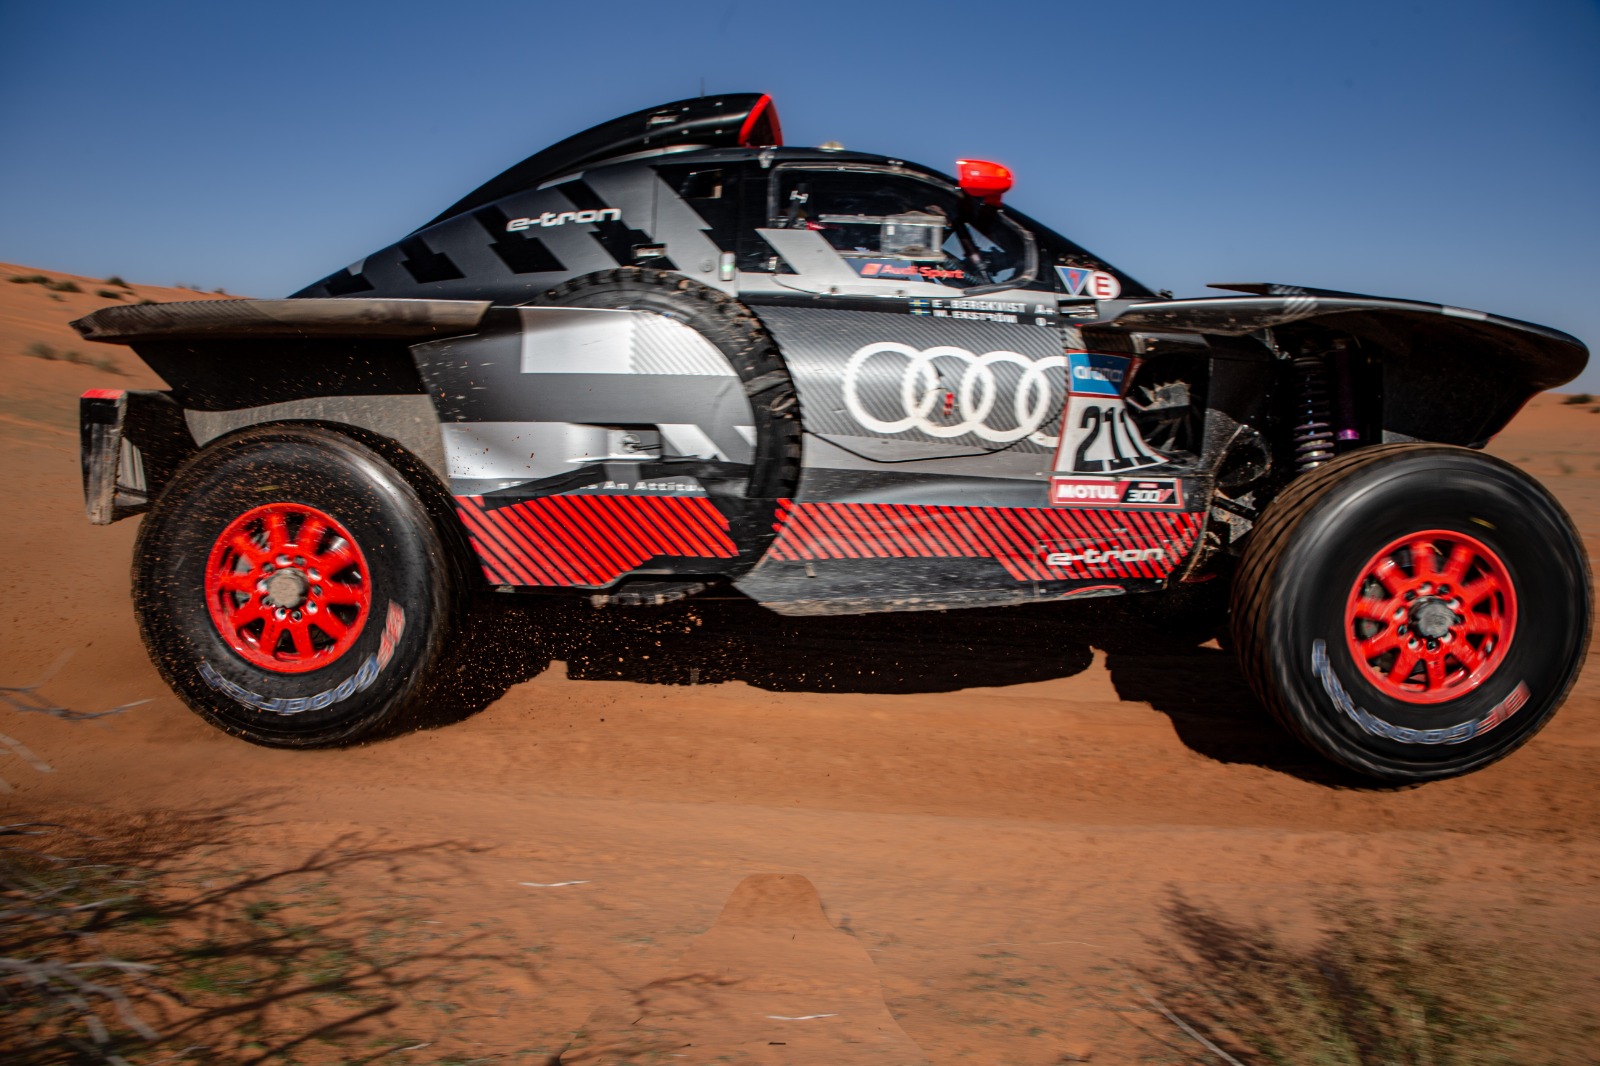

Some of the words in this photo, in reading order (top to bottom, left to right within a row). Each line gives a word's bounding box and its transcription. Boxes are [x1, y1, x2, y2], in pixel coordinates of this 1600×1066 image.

[506, 207, 622, 232] e-tron
[881, 264, 919, 275] Audi
[919, 267, 964, 279] Sport
[1095, 275, 1111, 296] E
[1056, 484, 1119, 498] MOTUL
[1126, 488, 1174, 502] 300V
[1046, 548, 1165, 566] e-tron
